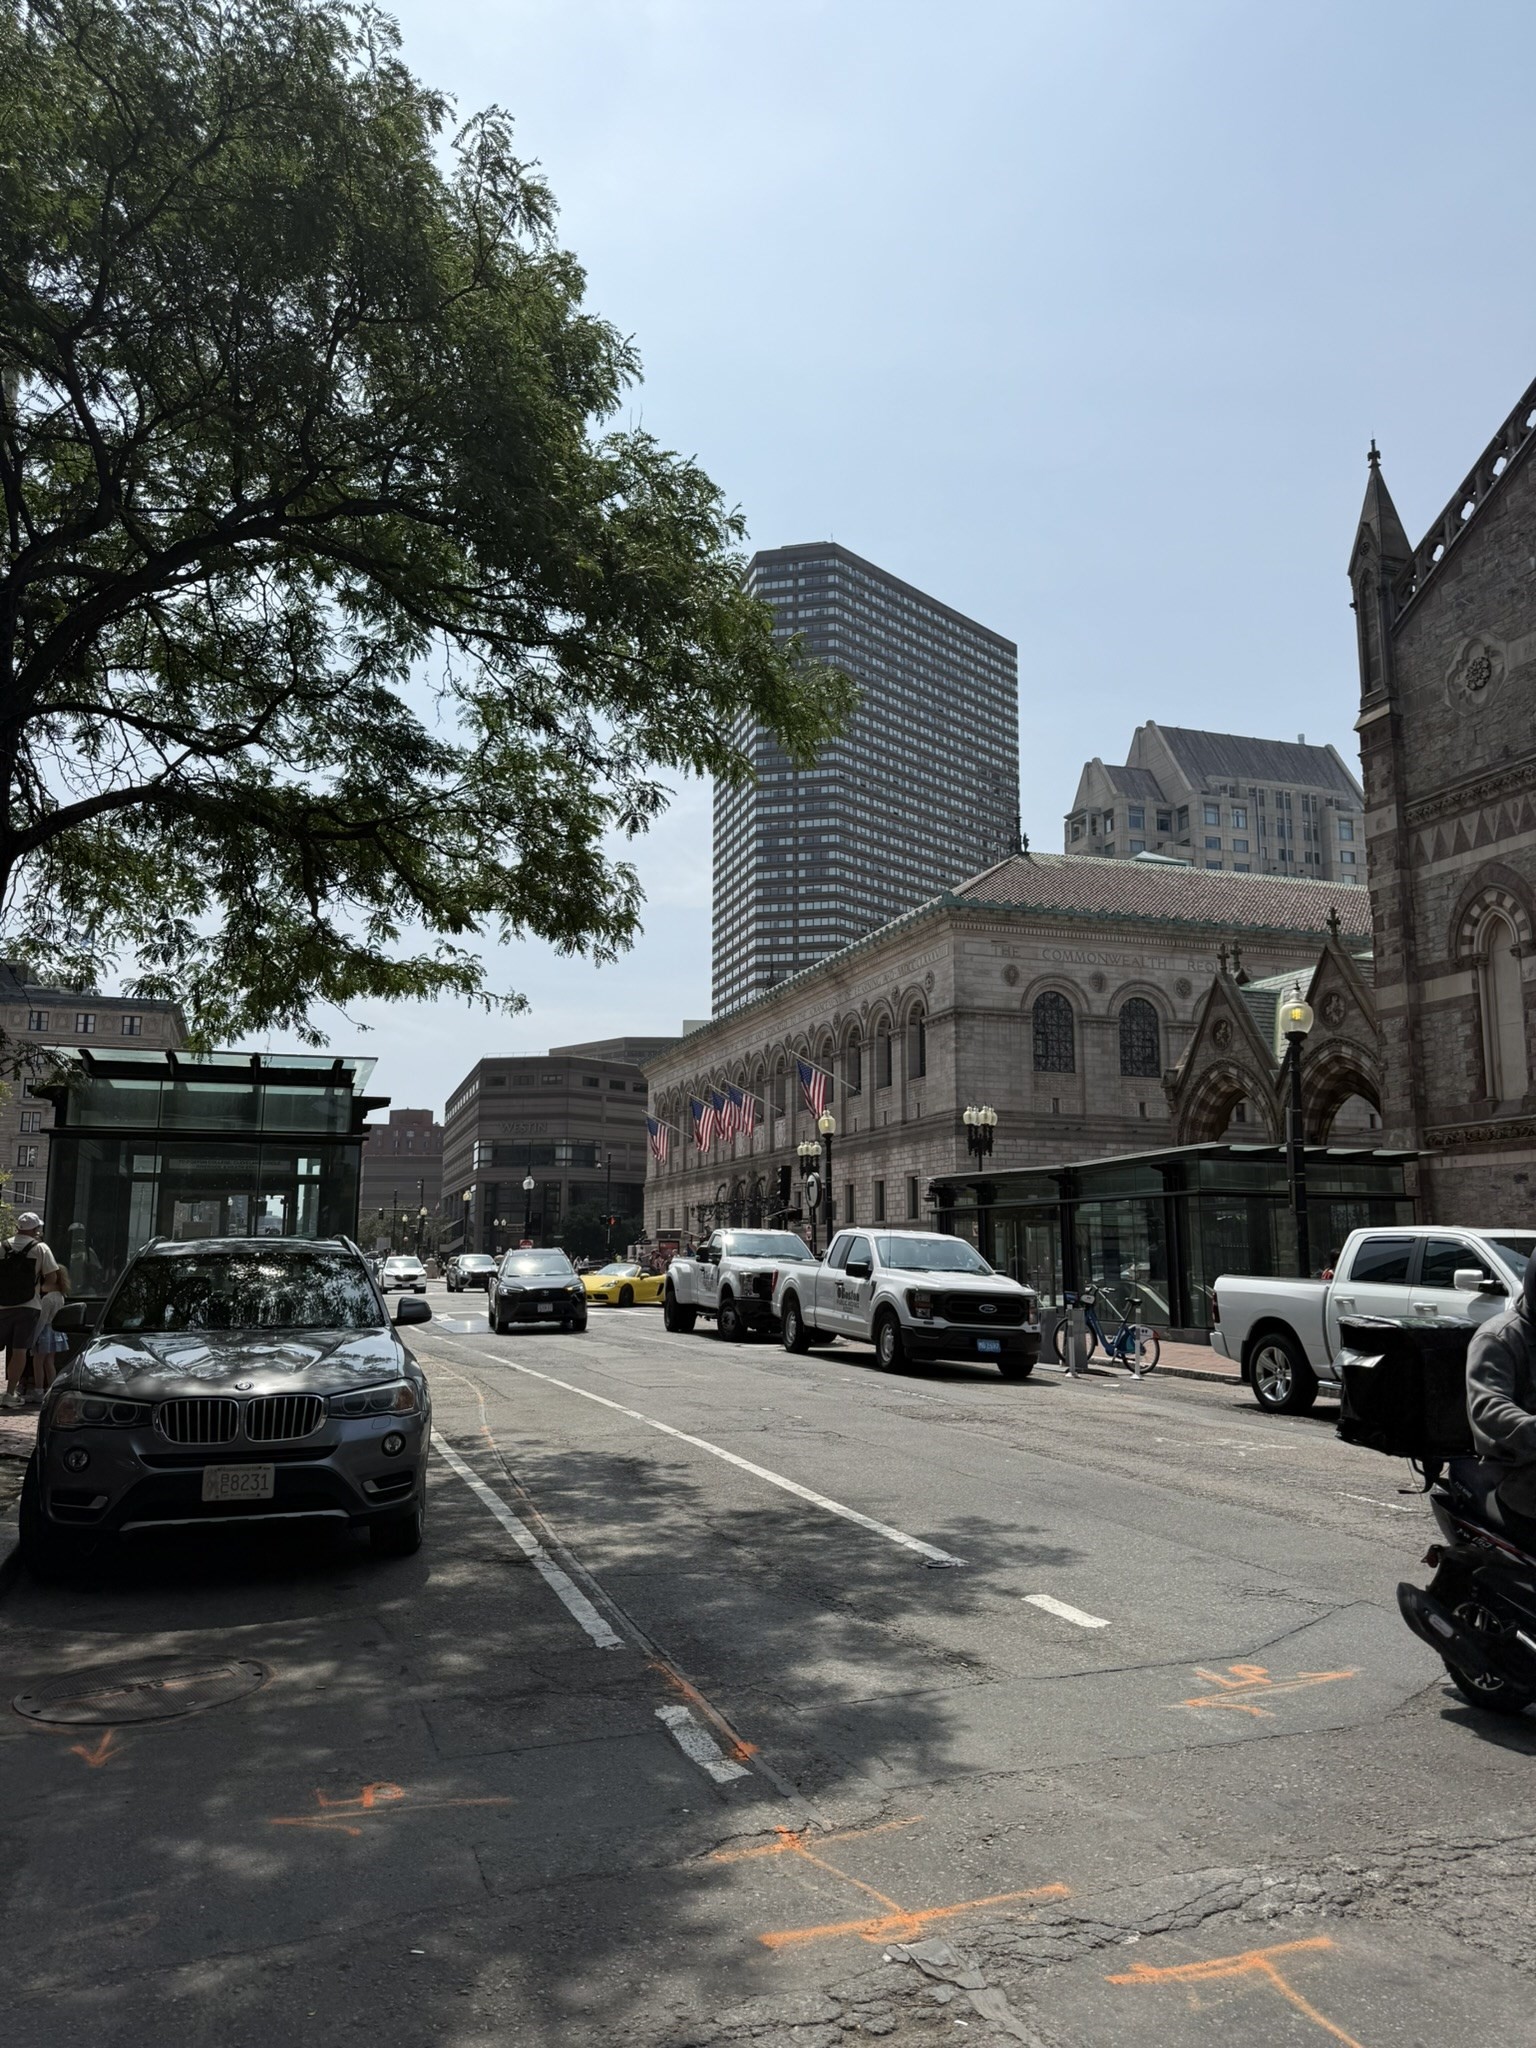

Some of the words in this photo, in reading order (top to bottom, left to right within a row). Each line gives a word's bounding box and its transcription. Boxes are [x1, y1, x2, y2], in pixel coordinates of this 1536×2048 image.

[992, 945, 1021, 958] THE
[1041, 948, 1167, 969] COMMONWEALTH
[501, 1120, 548, 1134] WESTIN
